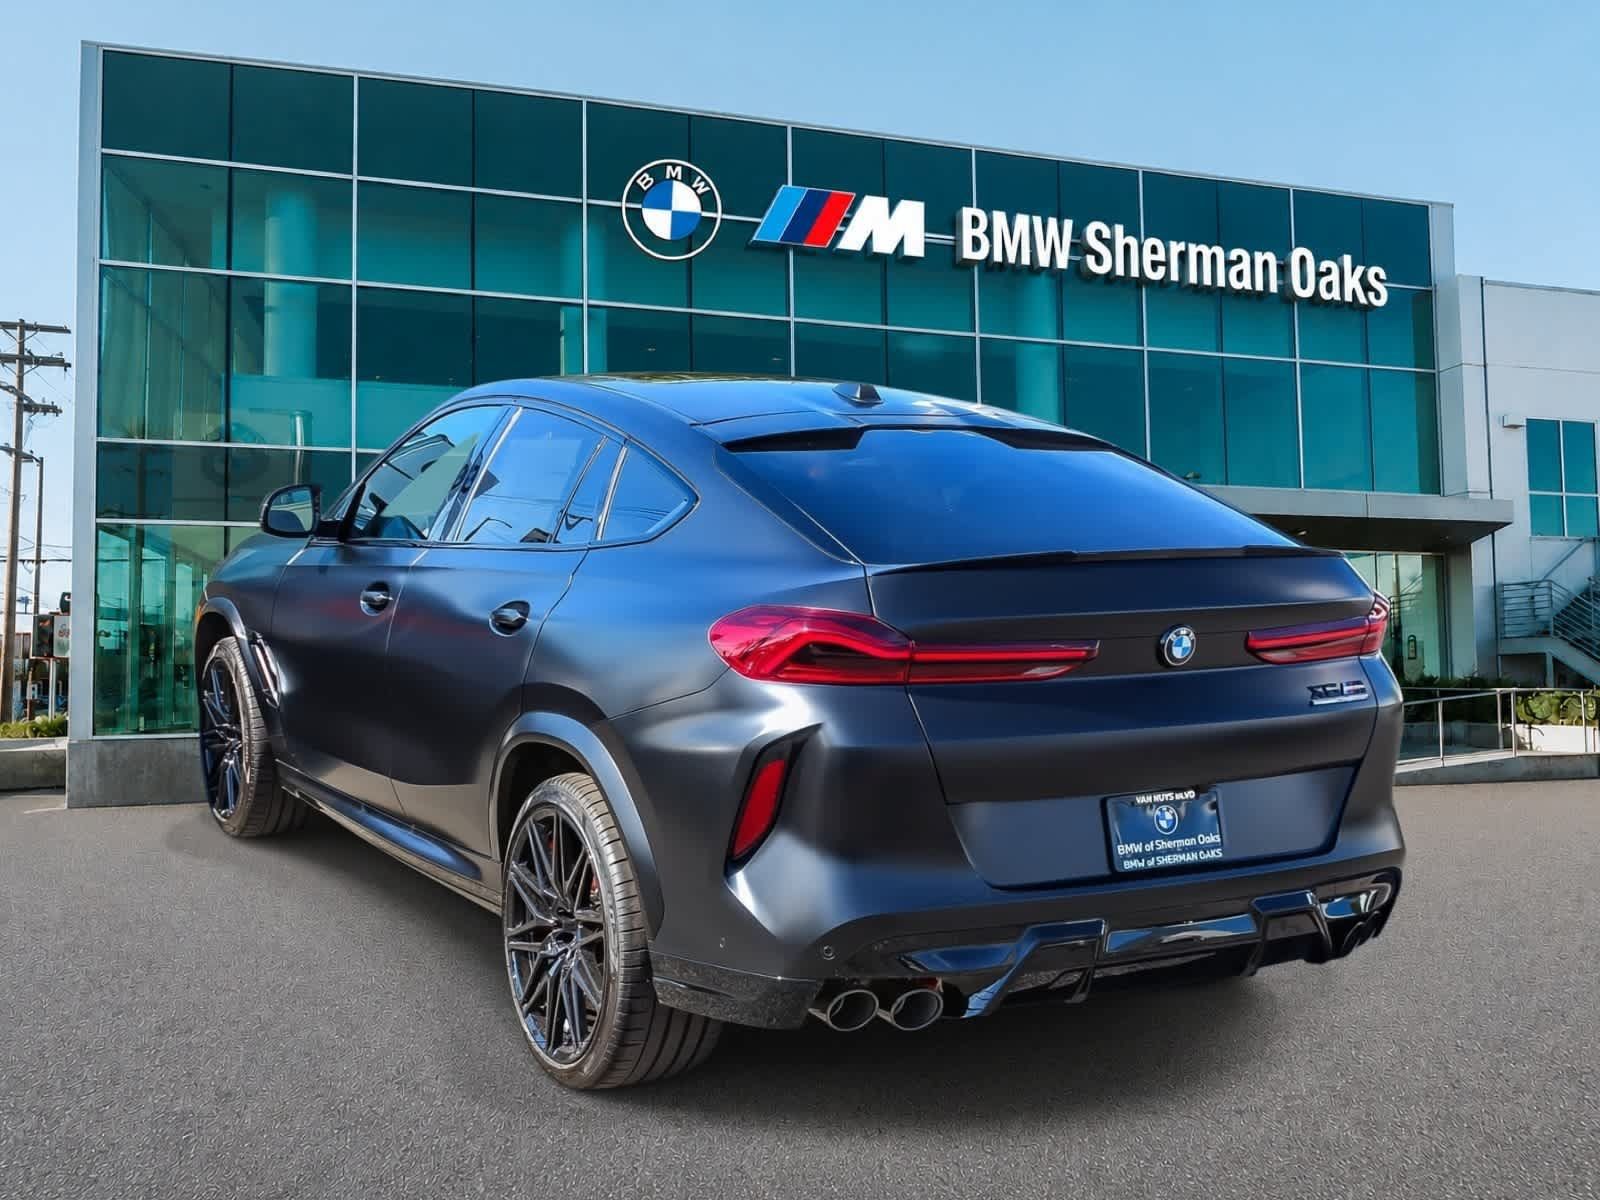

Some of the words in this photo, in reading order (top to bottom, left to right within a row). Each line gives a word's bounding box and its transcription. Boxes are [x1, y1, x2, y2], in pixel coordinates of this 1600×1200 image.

[636, 165, 711, 195] BMW
[836, 194, 925, 257] M
[960, 206, 1073, 270] BMW
[1084, 220, 1279, 294] Sherman
[1290, 246, 1389, 307] Oaks
[1117, 841, 1143, 855] BMW
[1144, 839, 1155, 851] of
[1155, 836, 1196, 850] Sherman
[1197, 833, 1221, 844] Oaks
[1123, 857, 1146, 870] BMW
[1147, 856, 1155, 867] of
[1156, 852, 1198, 865] SHERMAN
[1199, 848, 1223, 860] OAKS
